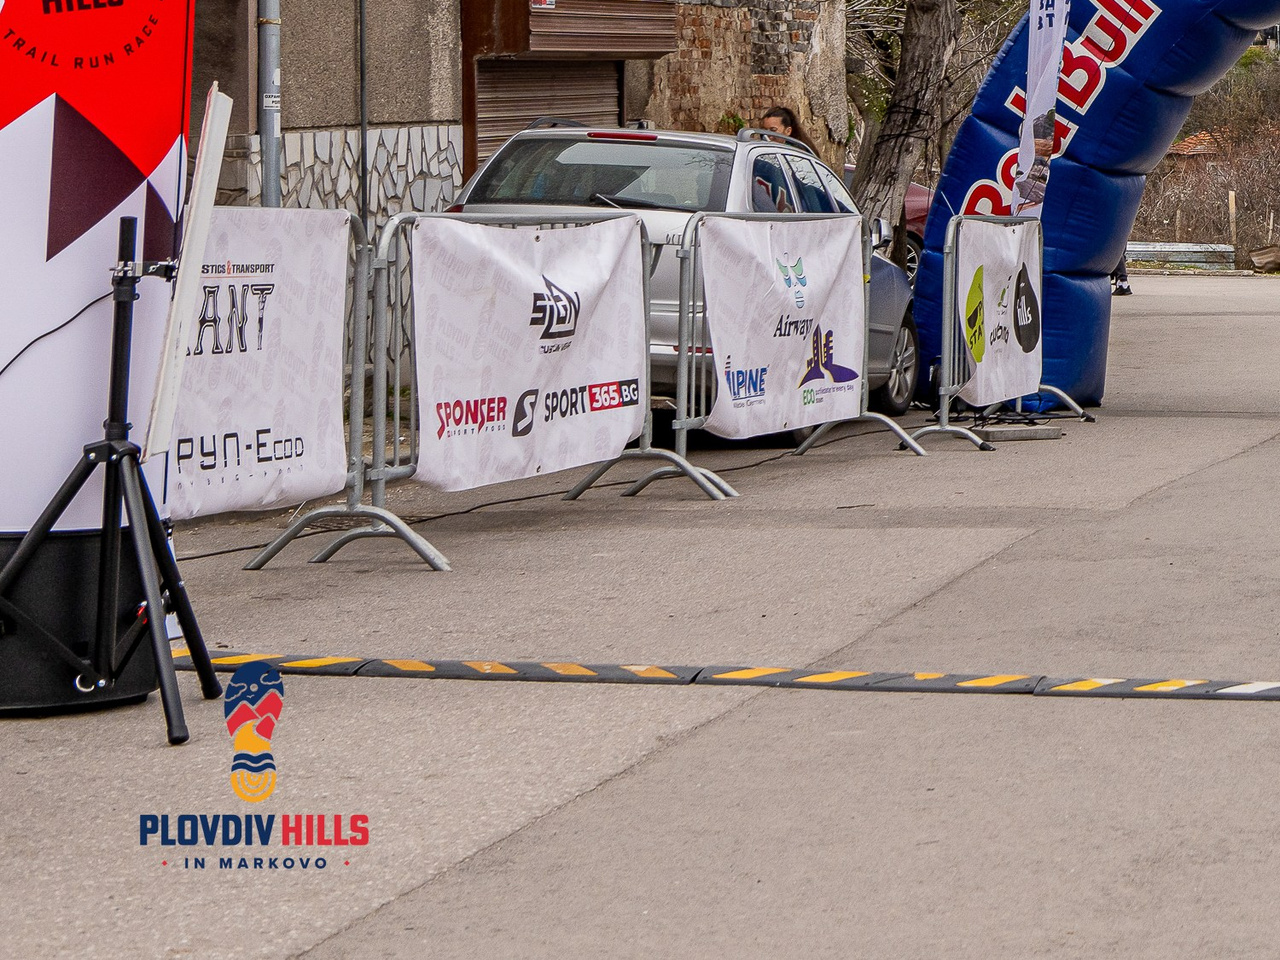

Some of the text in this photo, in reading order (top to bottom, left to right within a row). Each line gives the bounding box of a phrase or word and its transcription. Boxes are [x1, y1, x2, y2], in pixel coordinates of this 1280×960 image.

[3, 14, 159, 71] TRAIL RUN RACE
[186, 283, 276, 357] ANT
[436, 395, 508, 441] SPONSER
